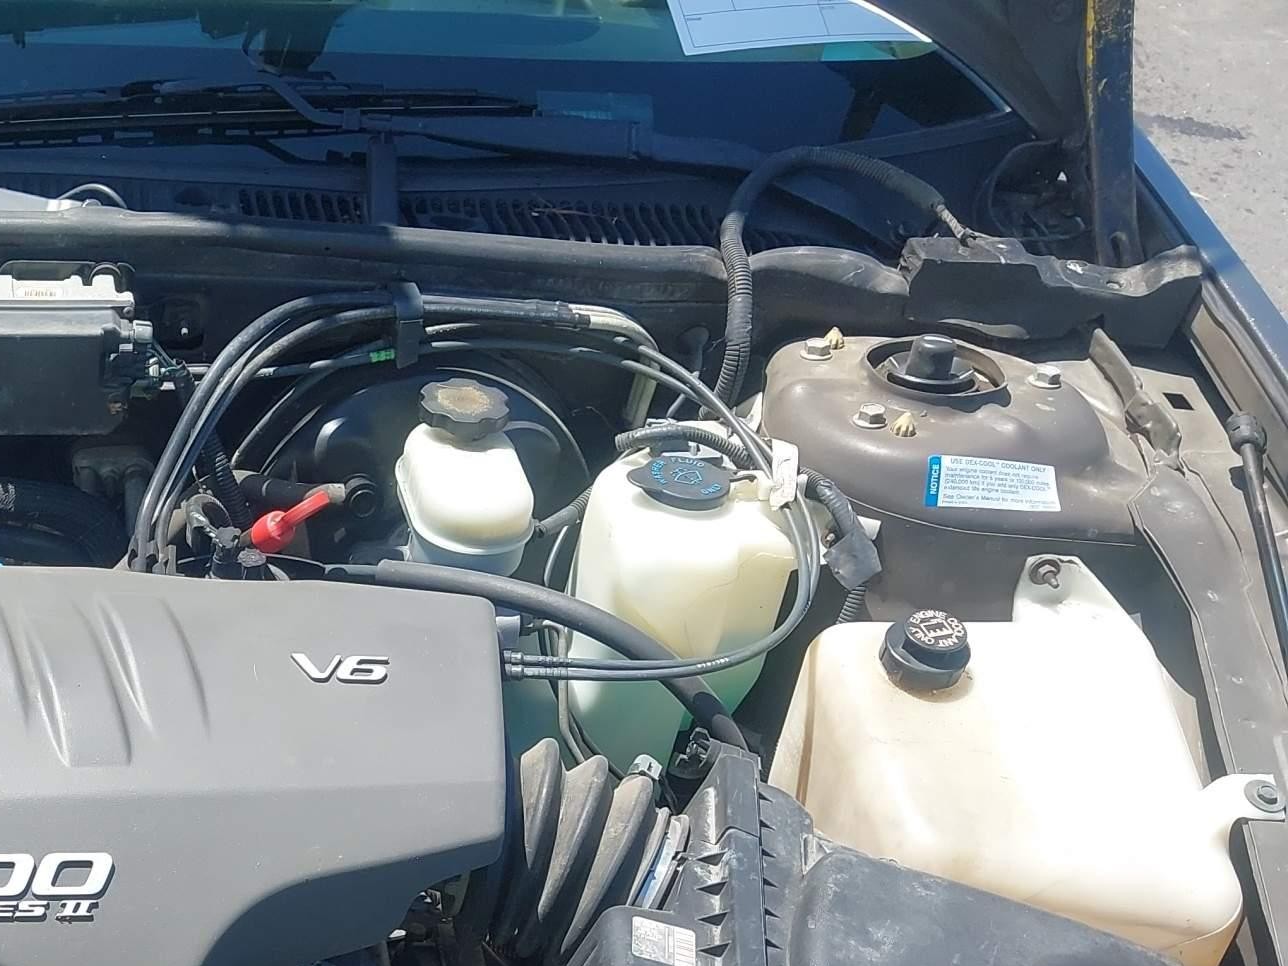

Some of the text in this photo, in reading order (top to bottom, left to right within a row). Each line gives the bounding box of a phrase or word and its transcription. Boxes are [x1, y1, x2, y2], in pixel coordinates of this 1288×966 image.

[671, 457, 705, 468] FLUID
[950, 457, 963, 465] USE
[1000, 461, 1029, 471] COOLANT
[1030, 465, 1046, 473] ONLY
[930, 464, 940, 495] NOTICE
[910, 609, 948, 624] ENGINE
[910, 626, 935, 645] ONLY
[291, 652, 390, 684] V6
[56, 900, 98, 923] II
